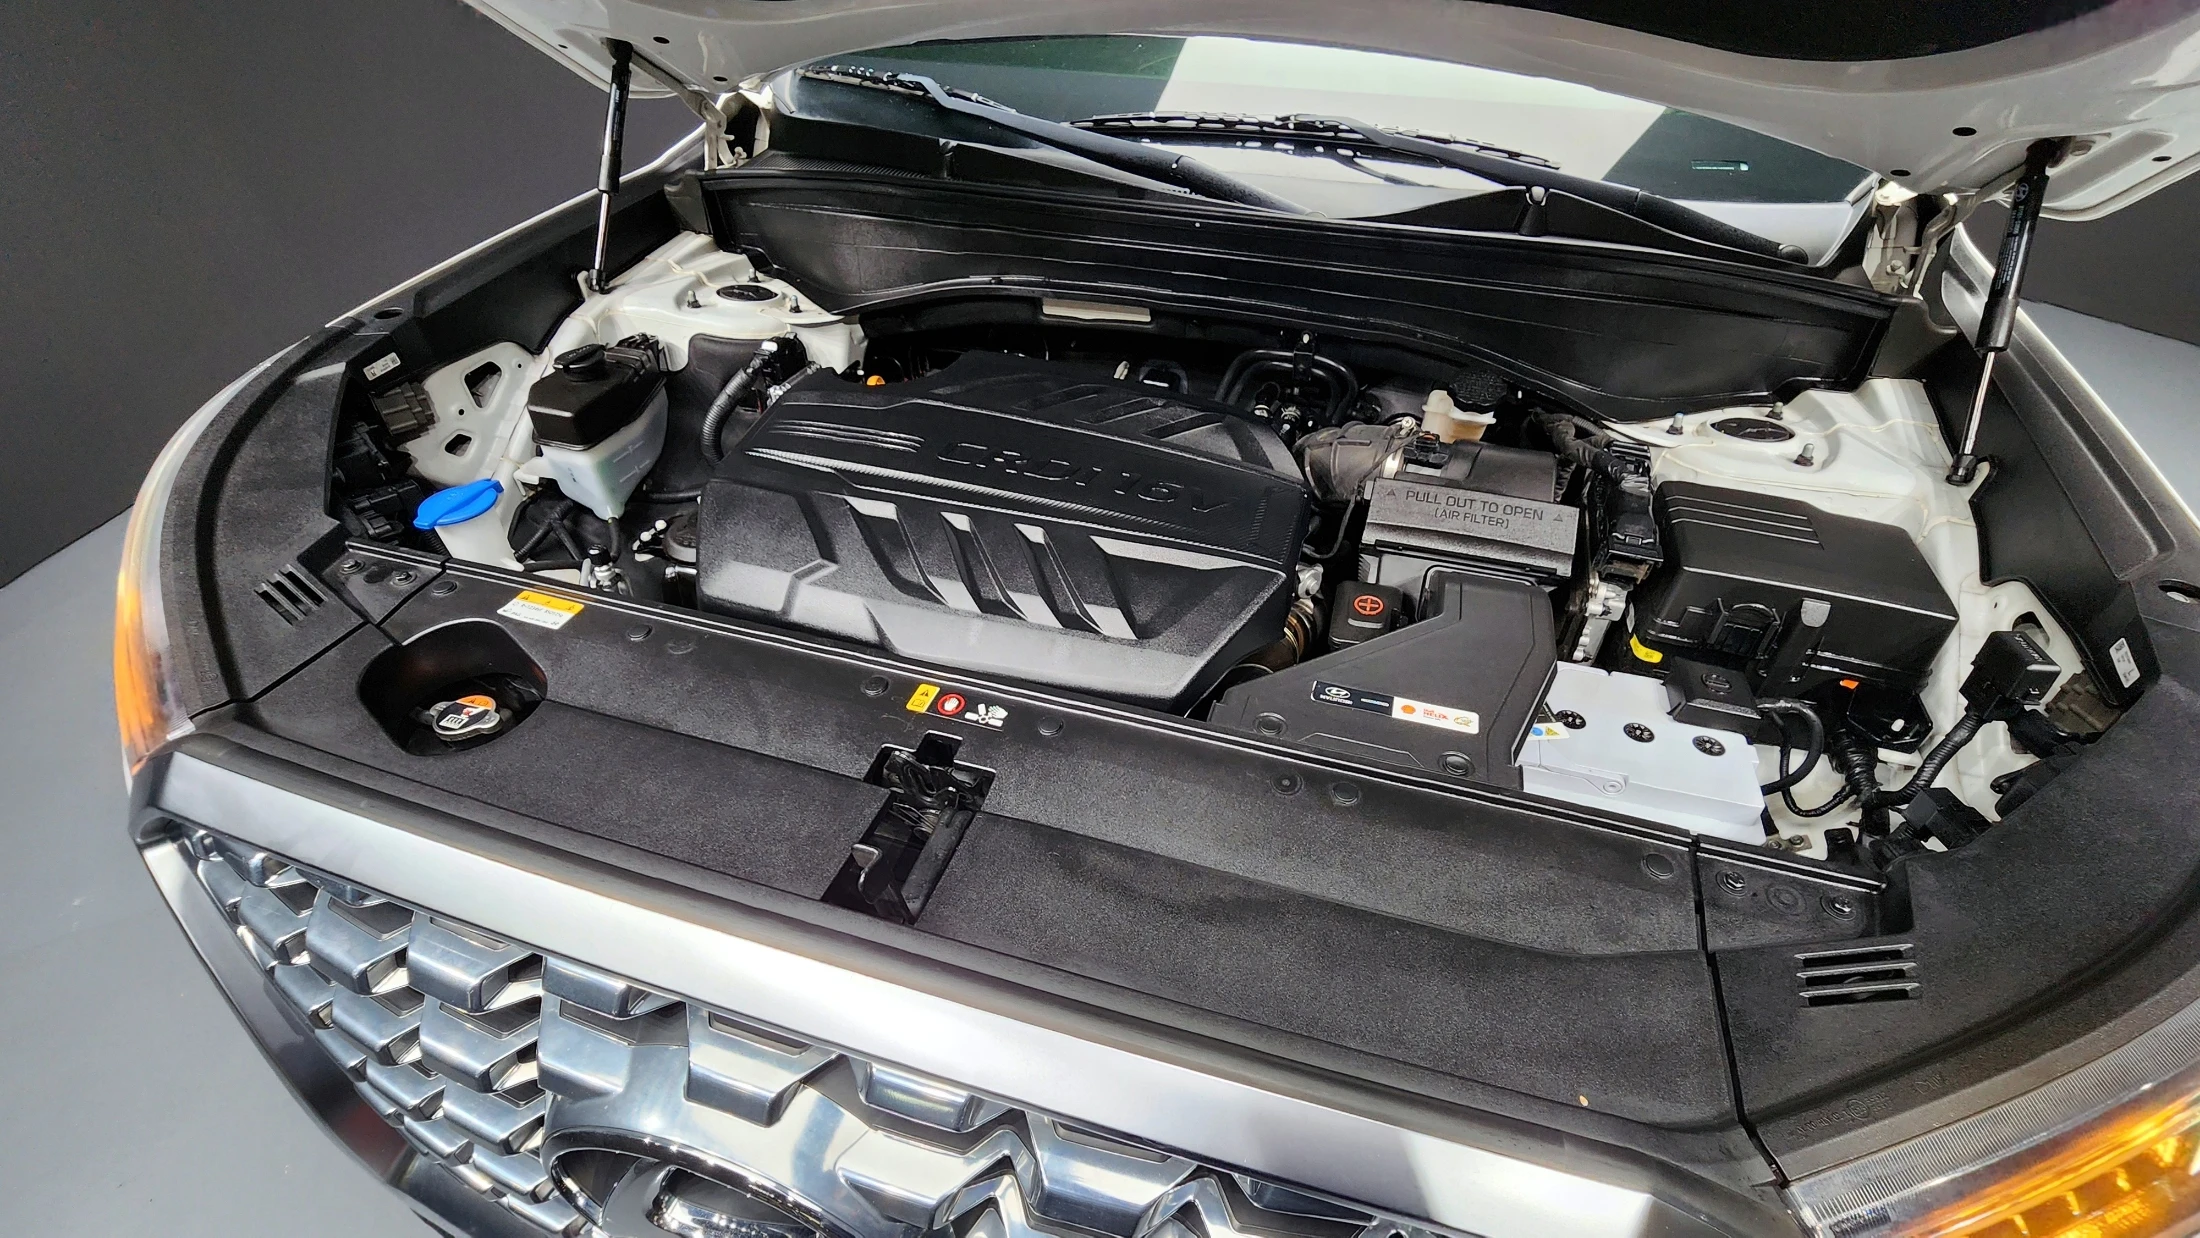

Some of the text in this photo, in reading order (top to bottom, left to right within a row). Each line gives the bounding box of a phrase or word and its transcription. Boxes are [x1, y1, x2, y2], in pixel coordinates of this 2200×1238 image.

[1113, 471, 1238, 513] 16V
[1406, 490, 1544, 521] PULL OUT TO OPEN
[1463, 512, 1510, 529] FILTER)
